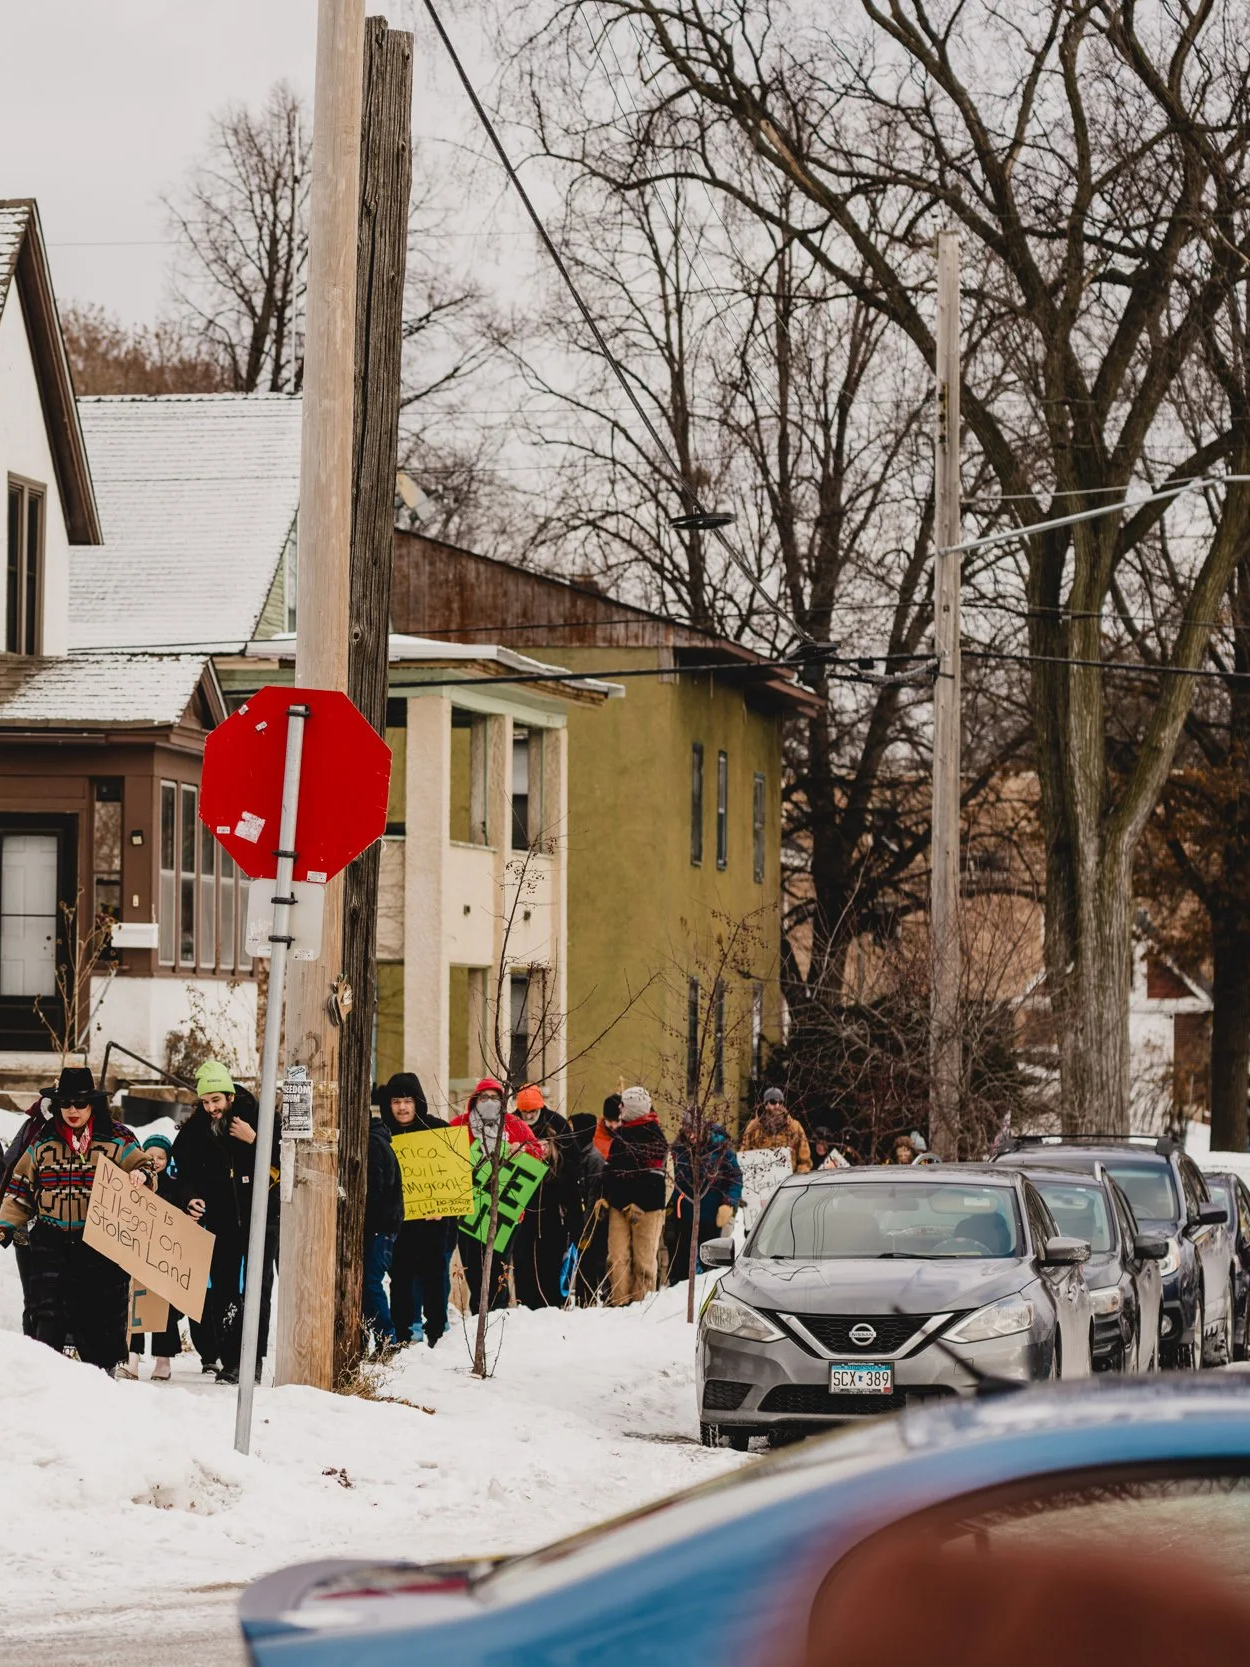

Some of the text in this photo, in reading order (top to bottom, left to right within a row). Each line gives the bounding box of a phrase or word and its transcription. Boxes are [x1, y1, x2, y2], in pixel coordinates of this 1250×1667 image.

[102, 1163, 174, 1226] No one is
[401, 1163, 447, 1178] built
[94, 1182, 155, 1240] Illegal
[89, 1205, 192, 1291] Stolen Land
[833, 1371, 889, 1387] SCX 389
